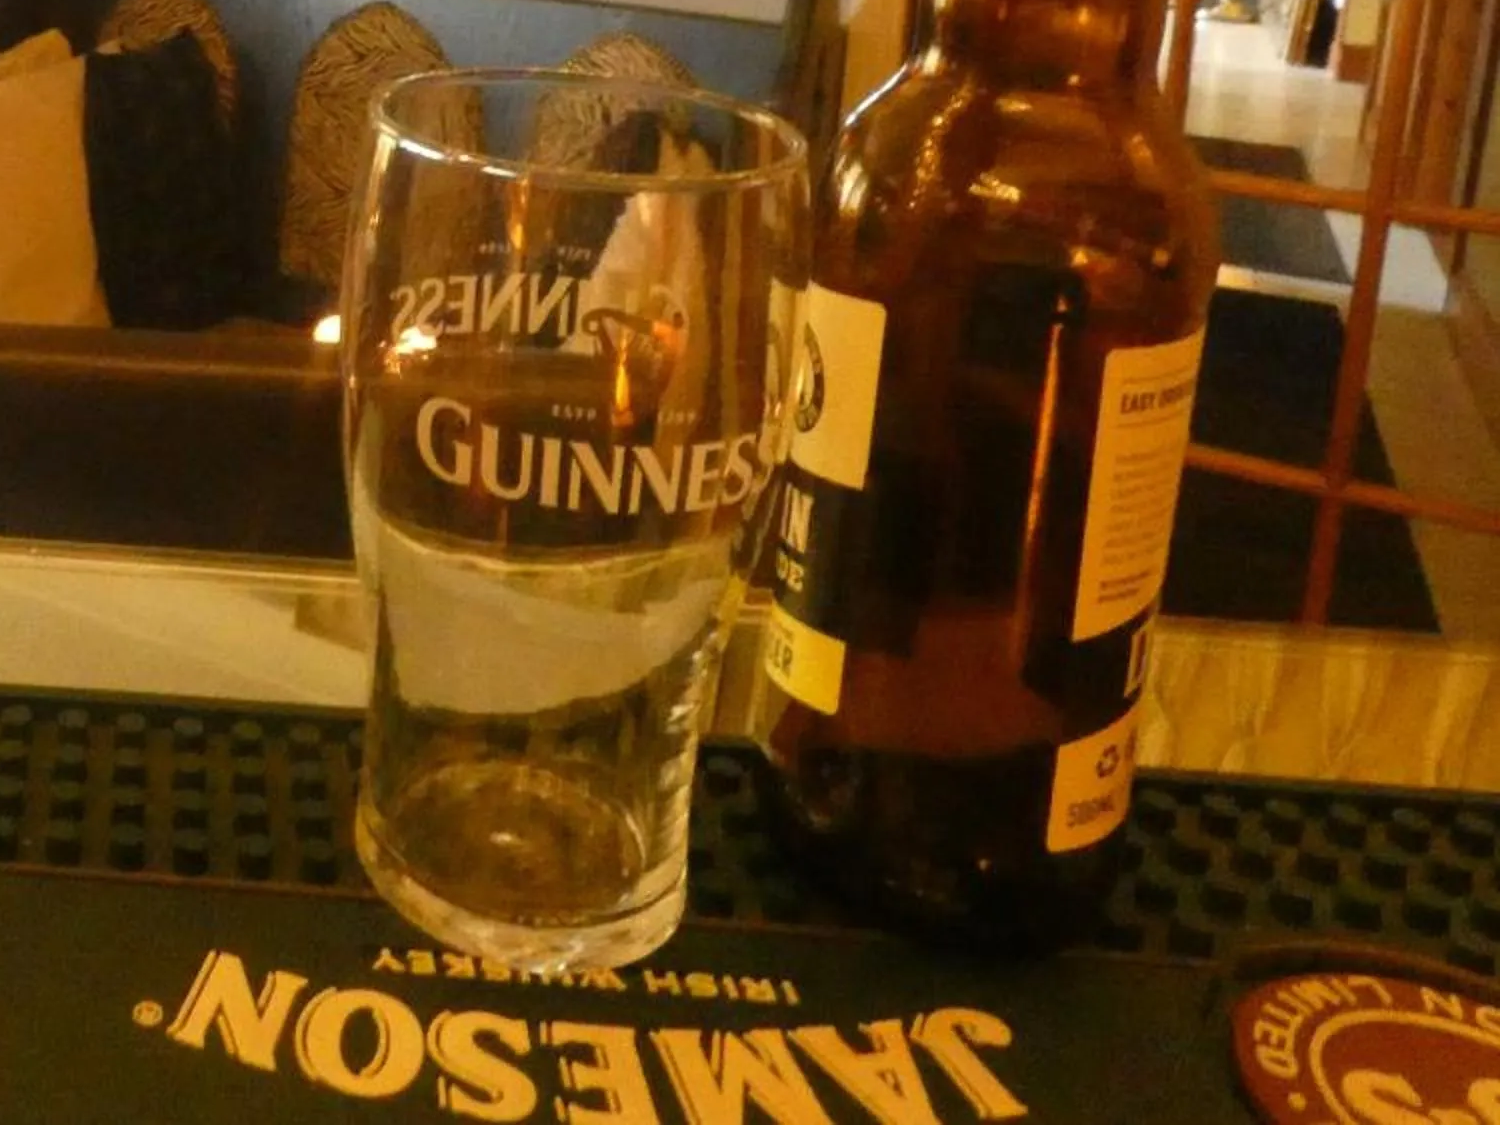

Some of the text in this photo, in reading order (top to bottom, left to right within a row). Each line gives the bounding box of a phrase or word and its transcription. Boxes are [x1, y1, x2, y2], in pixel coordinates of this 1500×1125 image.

[166, 948, 1027, 1125] JAMESON
[644, 968, 800, 1006] IRISH
[1253, 975, 1393, 1080] LIMITED
